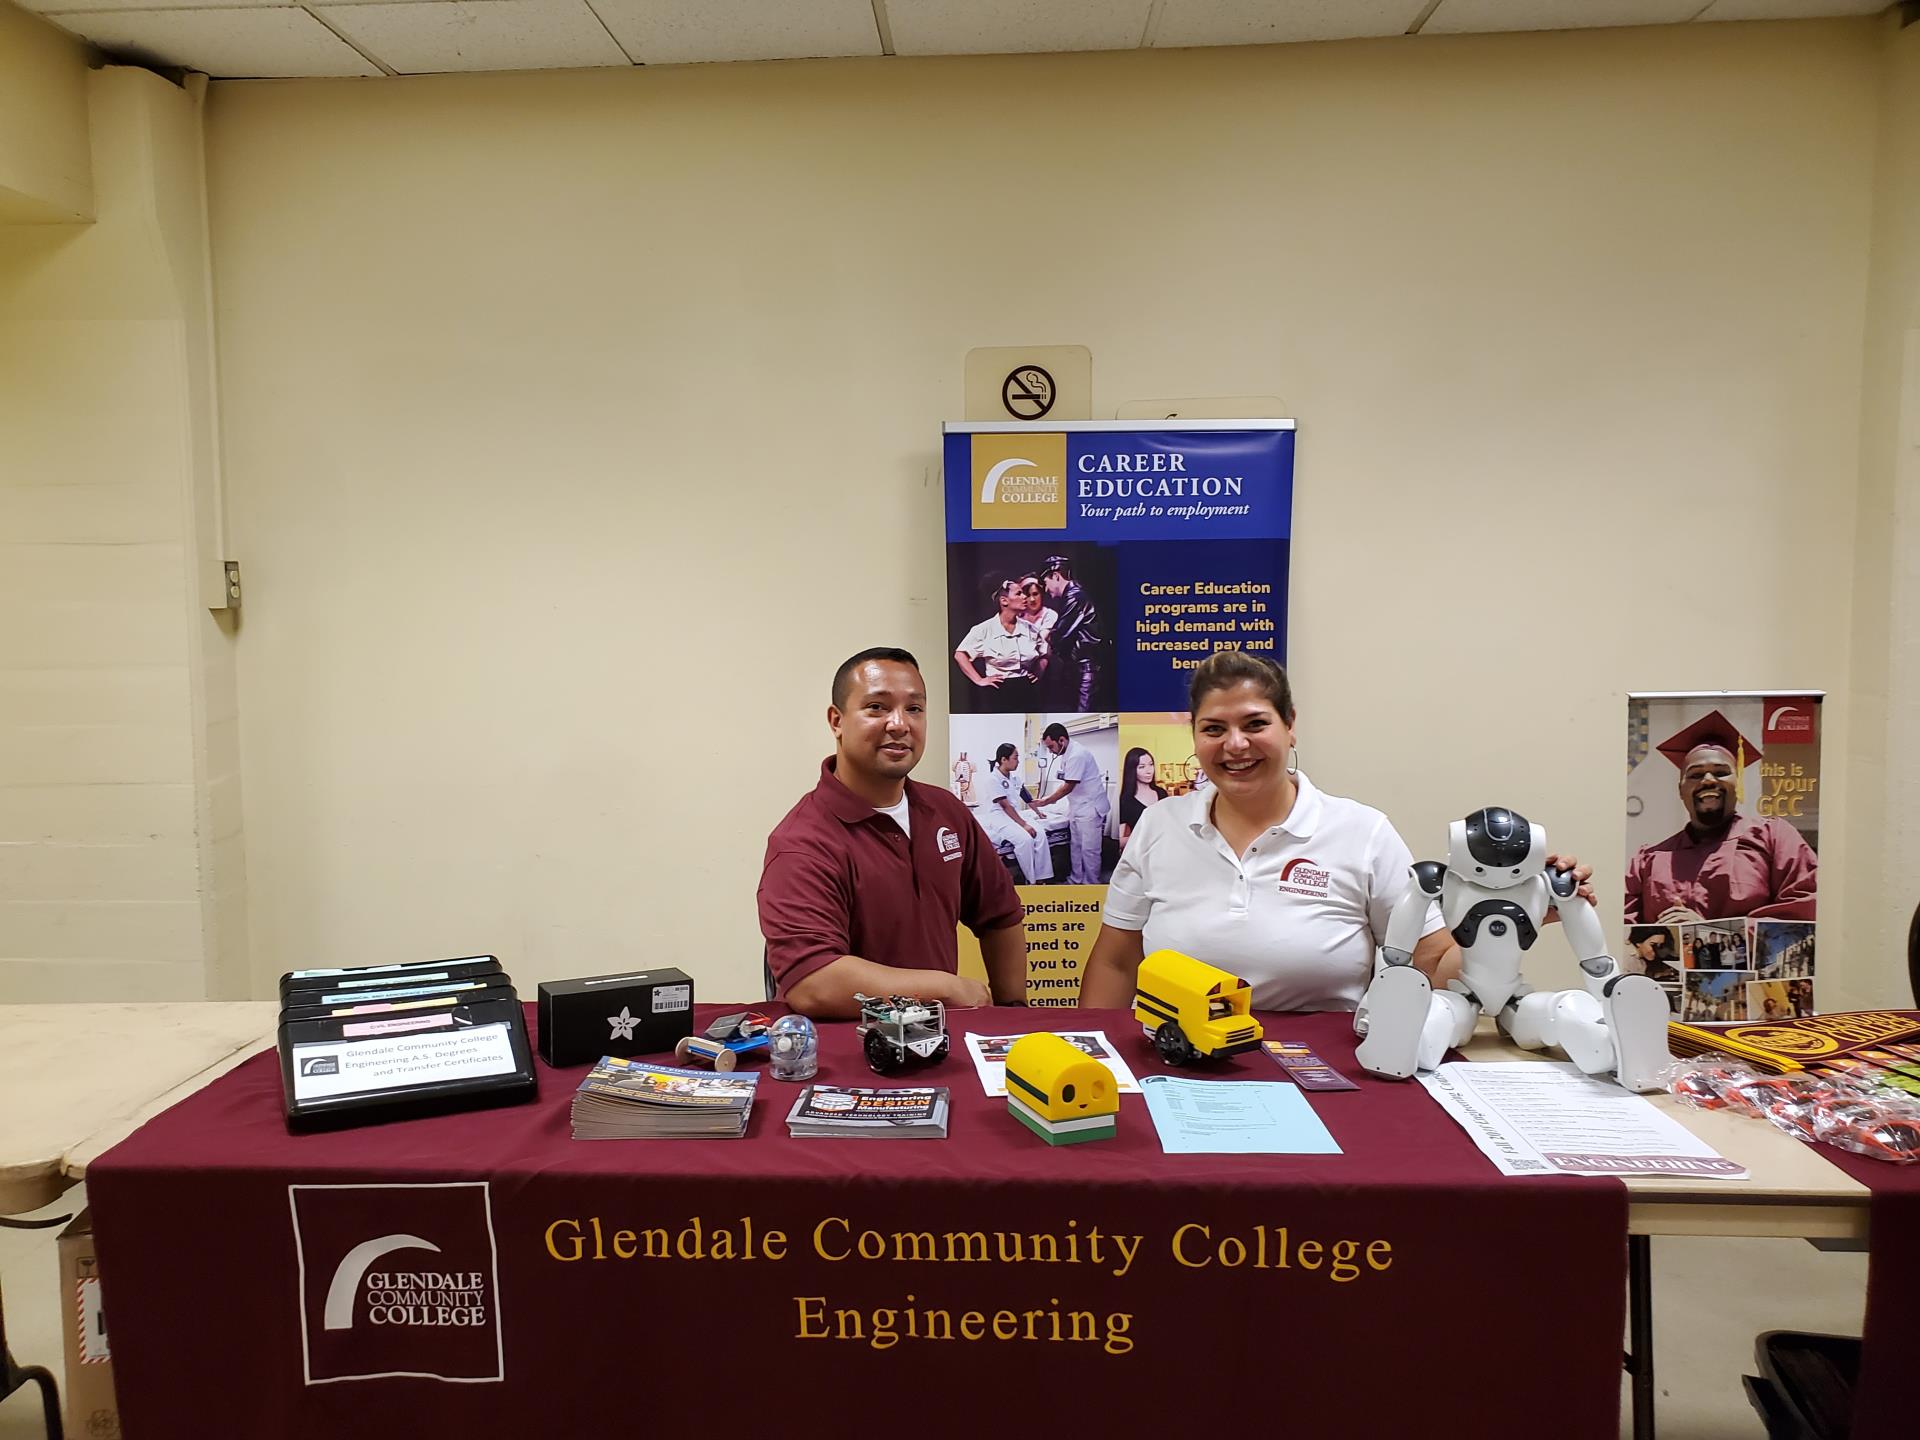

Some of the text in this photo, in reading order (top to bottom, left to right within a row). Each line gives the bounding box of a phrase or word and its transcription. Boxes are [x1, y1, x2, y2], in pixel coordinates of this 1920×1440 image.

[1077, 453, 1187, 473] CAREER
[1001, 476, 1058, 486] GLENDALE
[1077, 477, 1244, 498] EDUCATION
[1001, 492, 1058, 503] COLLEGE
[1080, 501, 1250, 521] Your path to employment
[1140, 581, 1271, 595] Career Education
[1144, 600, 1266, 616] programs are in
[1135, 618, 1275, 635] high demand with
[1136, 637, 1274, 653] increased pay and
[1760, 763, 1804, 777] this is
[1771, 778, 1817, 797] your
[1756, 795, 1804, 817] GCC
[1294, 867, 1330, 877] GLENDALE
[1292, 878, 1328, 888] COLLEGE
[1062, 922, 1085, 932] are
[1063, 940, 1079, 950] to
[1030, 958, 1077, 973] you to
[346, 1033, 499, 1058] Glendale Community College
[345, 1055, 410, 1069] Engineering
[412, 1052, 432, 1062] A.S.
[435, 1046, 478, 1060] Degrees
[372, 1053, 504, 1077] and Transfer Certificates
[1552, 1156, 1736, 1171] ENGINEERING
[544, 1216, 1394, 1283] Glendale Community College
[366, 1272, 485, 1290] GLENDALE
[366, 1290, 485, 1307] COMMUNITY
[368, 1305, 487, 1326] COLLEGE
[793, 1294, 1135, 1355] Engineering
